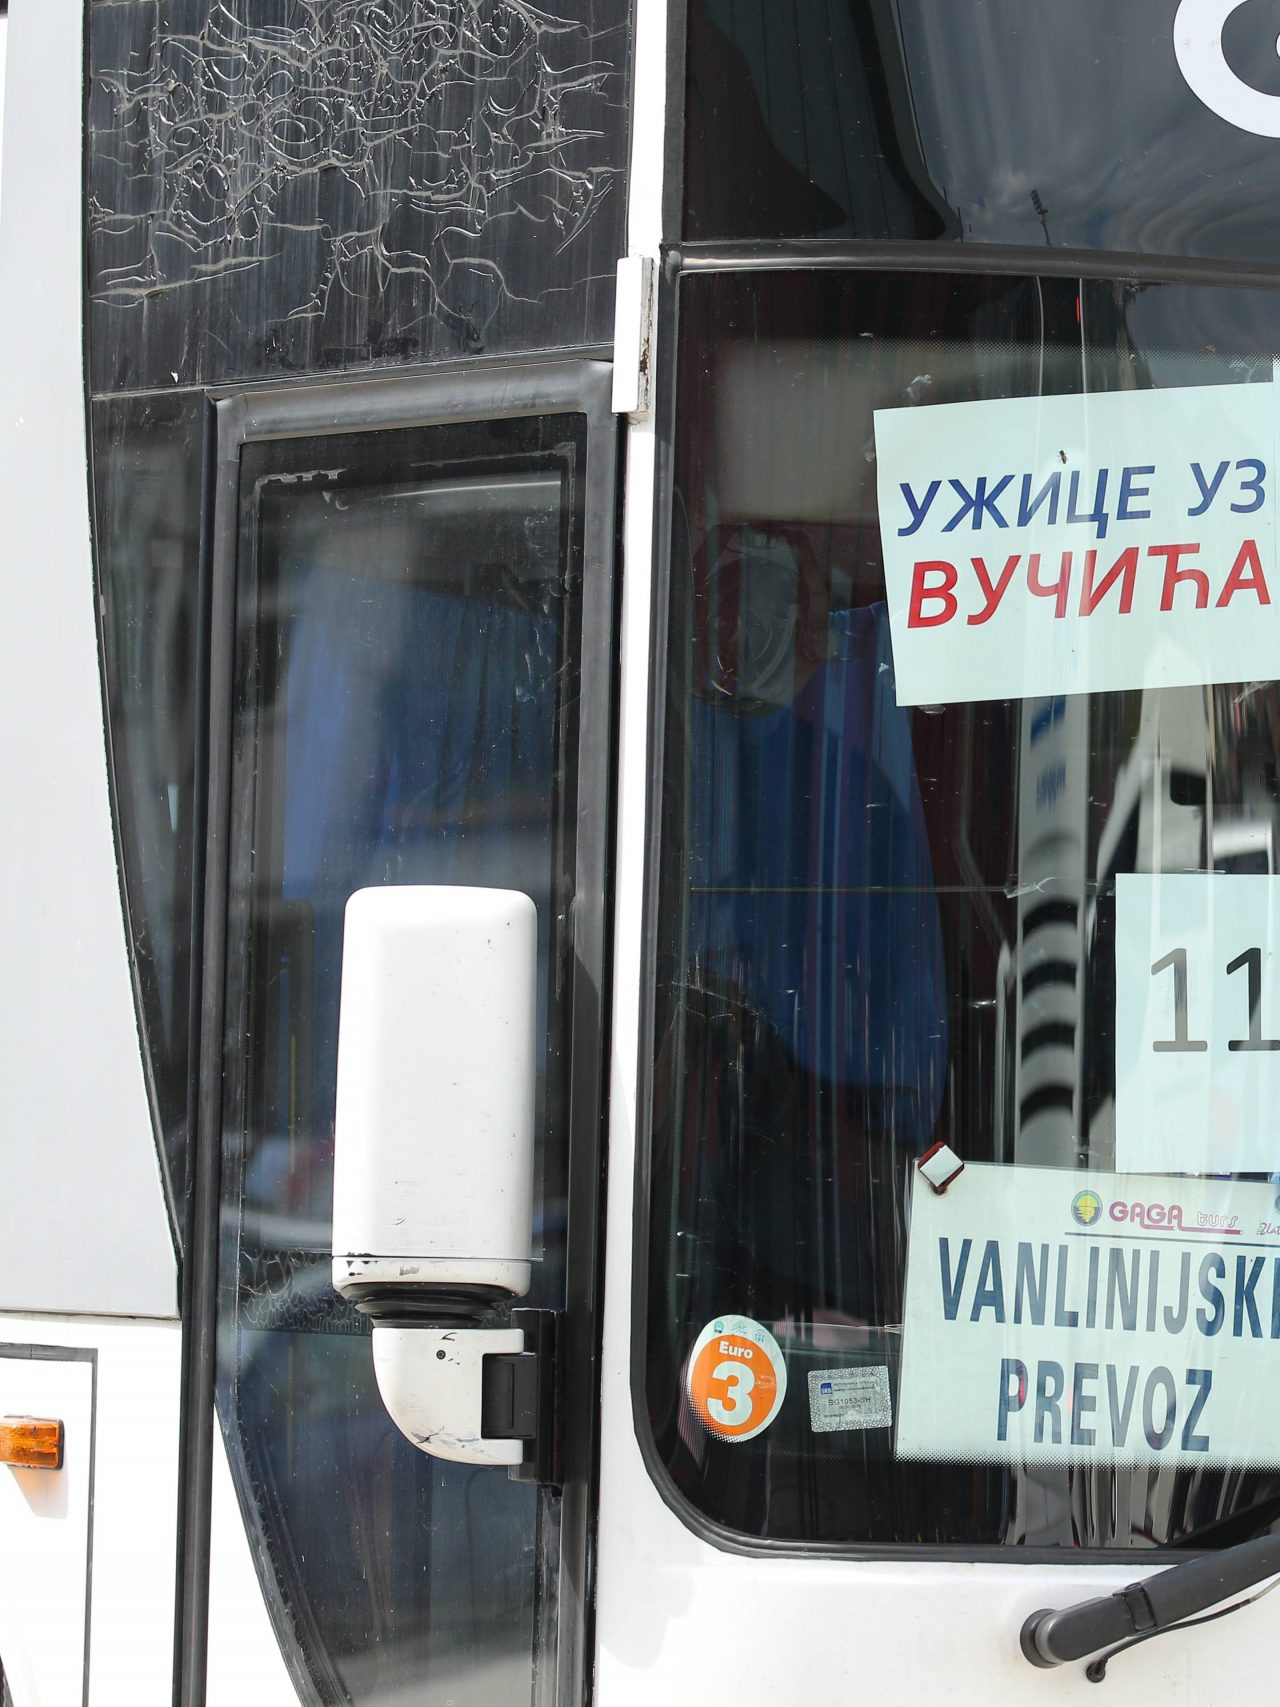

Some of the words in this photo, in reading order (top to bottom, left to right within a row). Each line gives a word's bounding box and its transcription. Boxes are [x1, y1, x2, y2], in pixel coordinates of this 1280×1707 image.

[897, 465, 1156, 539] УЖИЦЕ
[1187, 458, 1268, 517] УЗ
[907, 539, 1272, 629] ВУЧИЋА
[1151, 947, 1280, 1053] 11
[1109, 1201, 1183, 1229] GAGA
[1197, 1211, 1239, 1228] turs
[719, 1340, 754, 1359] Euro
[706, 1361, 756, 1426] 3
[996, 1358, 1213, 1452] PREVOZ
